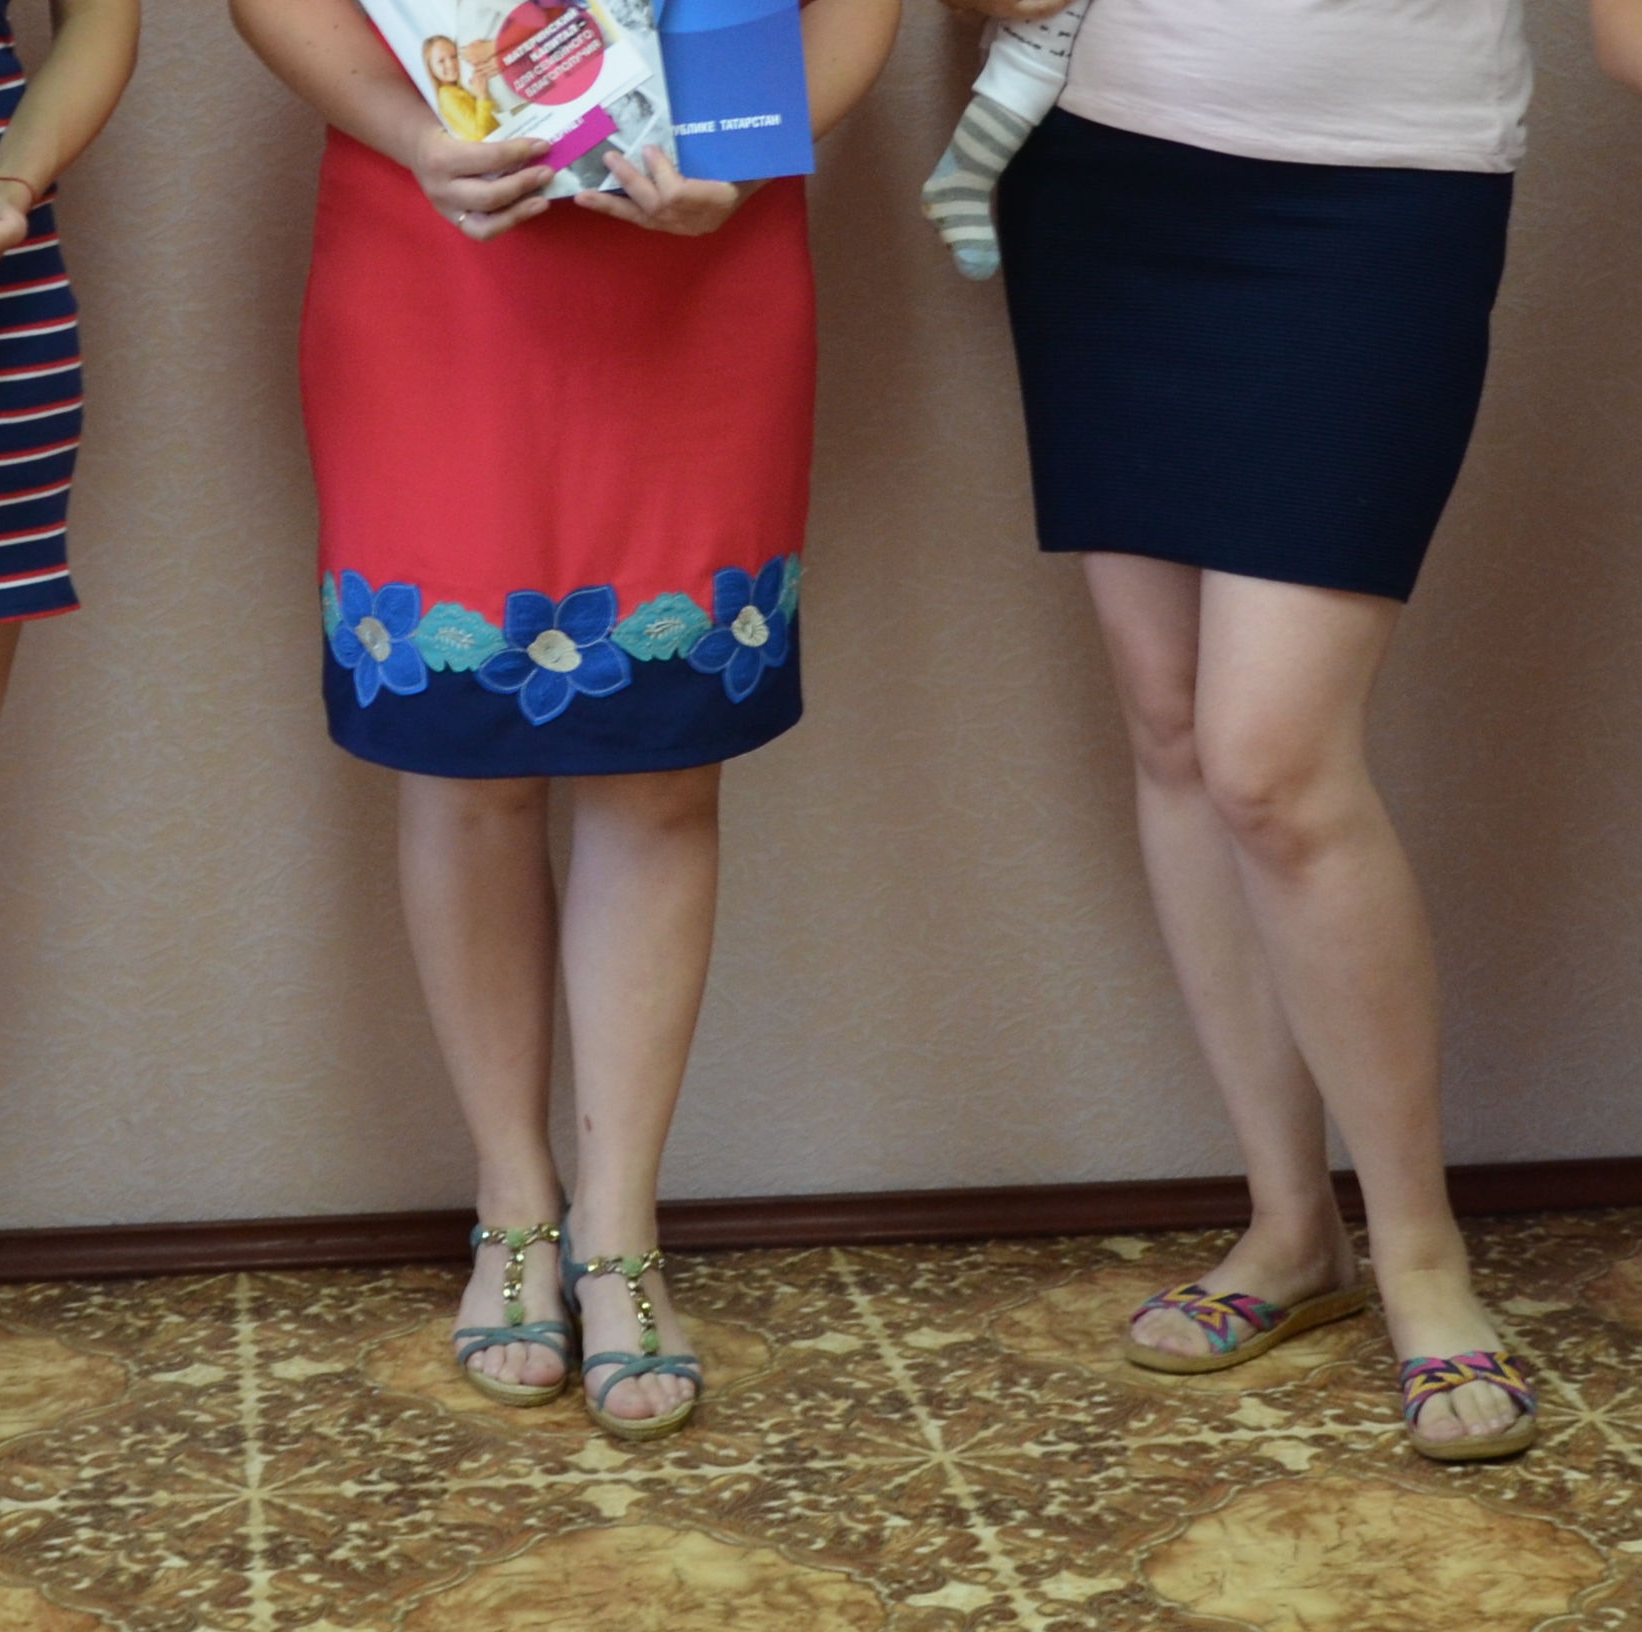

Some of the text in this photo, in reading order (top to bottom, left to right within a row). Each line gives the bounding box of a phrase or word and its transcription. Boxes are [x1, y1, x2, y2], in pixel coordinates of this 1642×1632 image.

[502, 7, 580, 66] МАТЕРИНСКИЙ
[514, 29, 593, 92] ДЛЯ СЕМЕЙНОГО
[529, 23, 579, 62] КАПИТАЛ
[525, 39, 602, 98] БЛАГОПОЛУЧИЯ
[719, 113, 782, 130] ТАТАРСТАН
